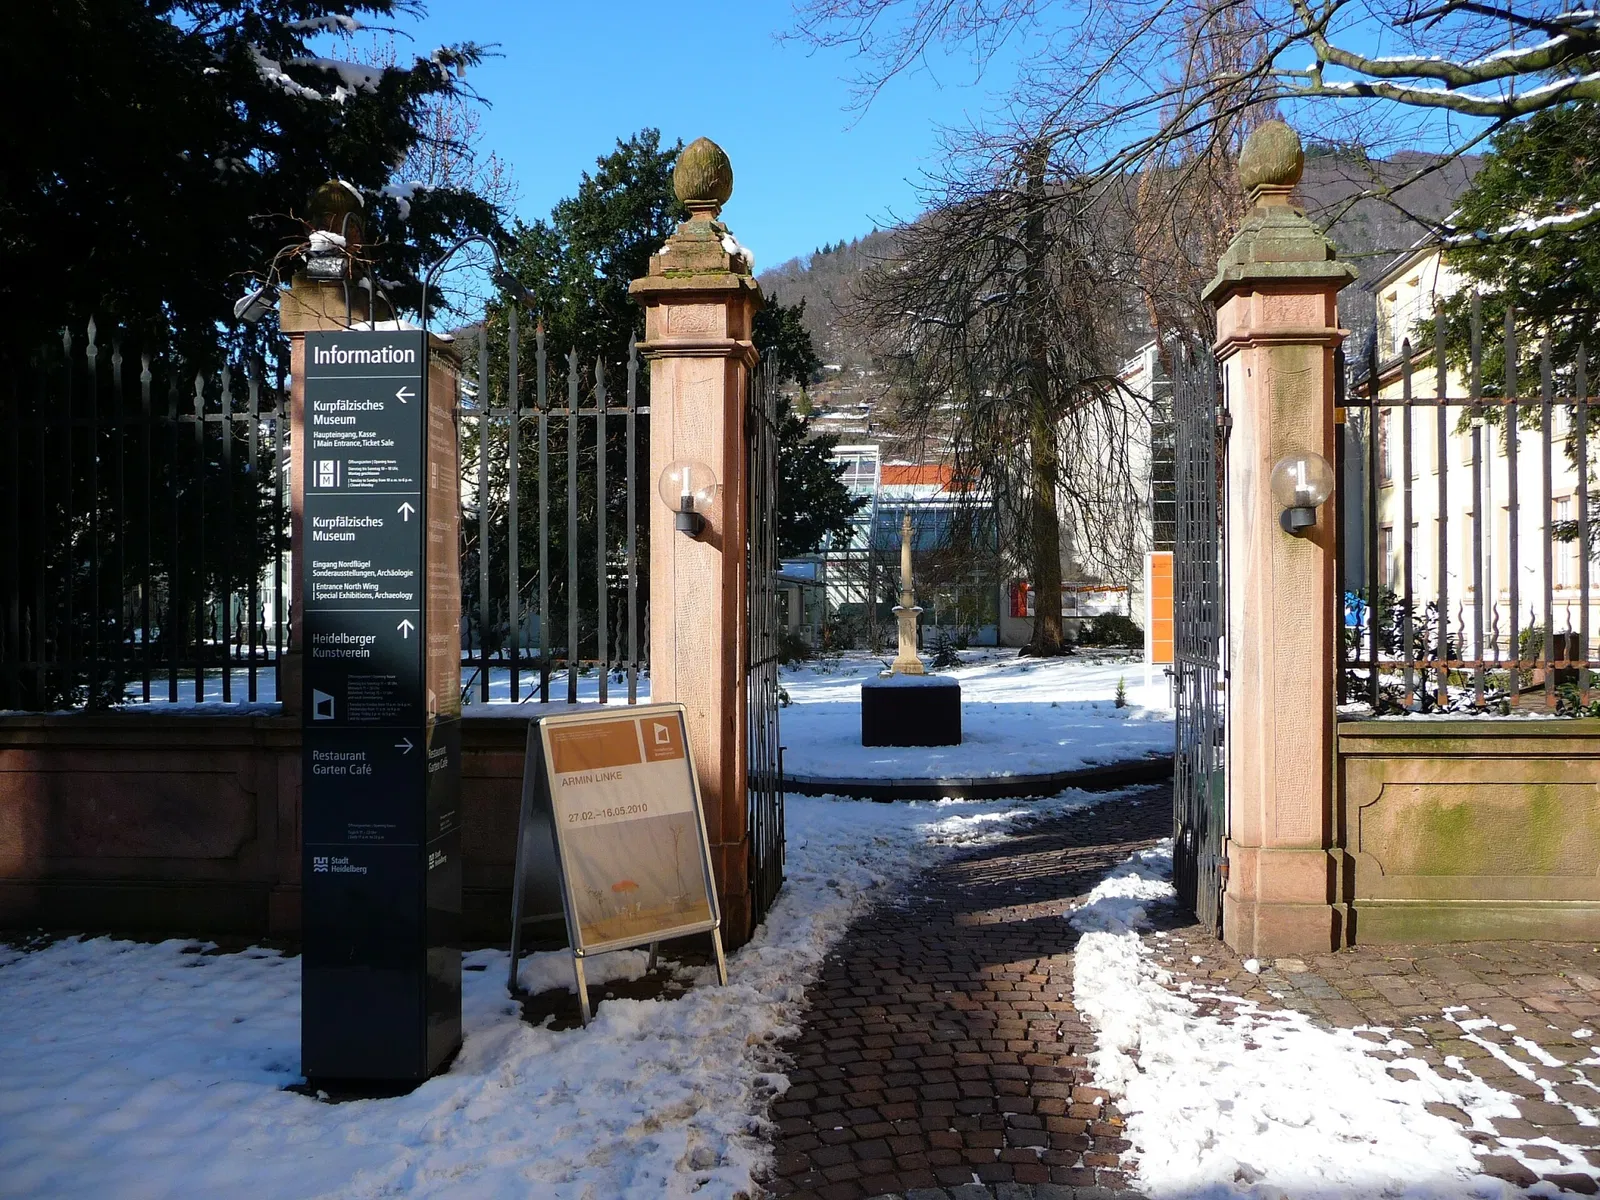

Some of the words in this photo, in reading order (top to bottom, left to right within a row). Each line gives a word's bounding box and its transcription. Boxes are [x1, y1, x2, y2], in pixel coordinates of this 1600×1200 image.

[314, 345, 415, 364] Information
[313, 400, 384, 413] Kurpfälzisches
[313, 414, 356, 425] Museum
[313, 431, 358, 439] Haupteingang,
[358, 430, 376, 438] Kasse
[333, 439, 362, 447] Entrance,
[381, 439, 394, 447] Sale
[312, 516, 384, 530] Kurpfälzisches
[312, 531, 355, 541] Museum
[312, 561, 337, 569] Eingang
[338, 560, 371, 569] Nordflügel
[312, 569, 376, 578] Sonderausstellungen,
[377, 569, 414, 578] Archäologie
[362, 583, 379, 591] Wing
[316, 592, 338, 600] Special
[339, 592, 374, 600] Exhibitions,
[374, 591, 413, 600] Archaeology
[312, 633, 376, 646] Heidelberger
[312, 647, 370, 658] Kunstverein
[312, 750, 366, 760] Restaurant
[312, 764, 346, 774] Garten
[349, 763, 372, 774] Café
[561, 775, 593, 787] ARMIN
[595, 771, 622, 783] LINKE
[331, 856, 349, 865] Stadt
[331, 864, 368, 874] Heidelberg
